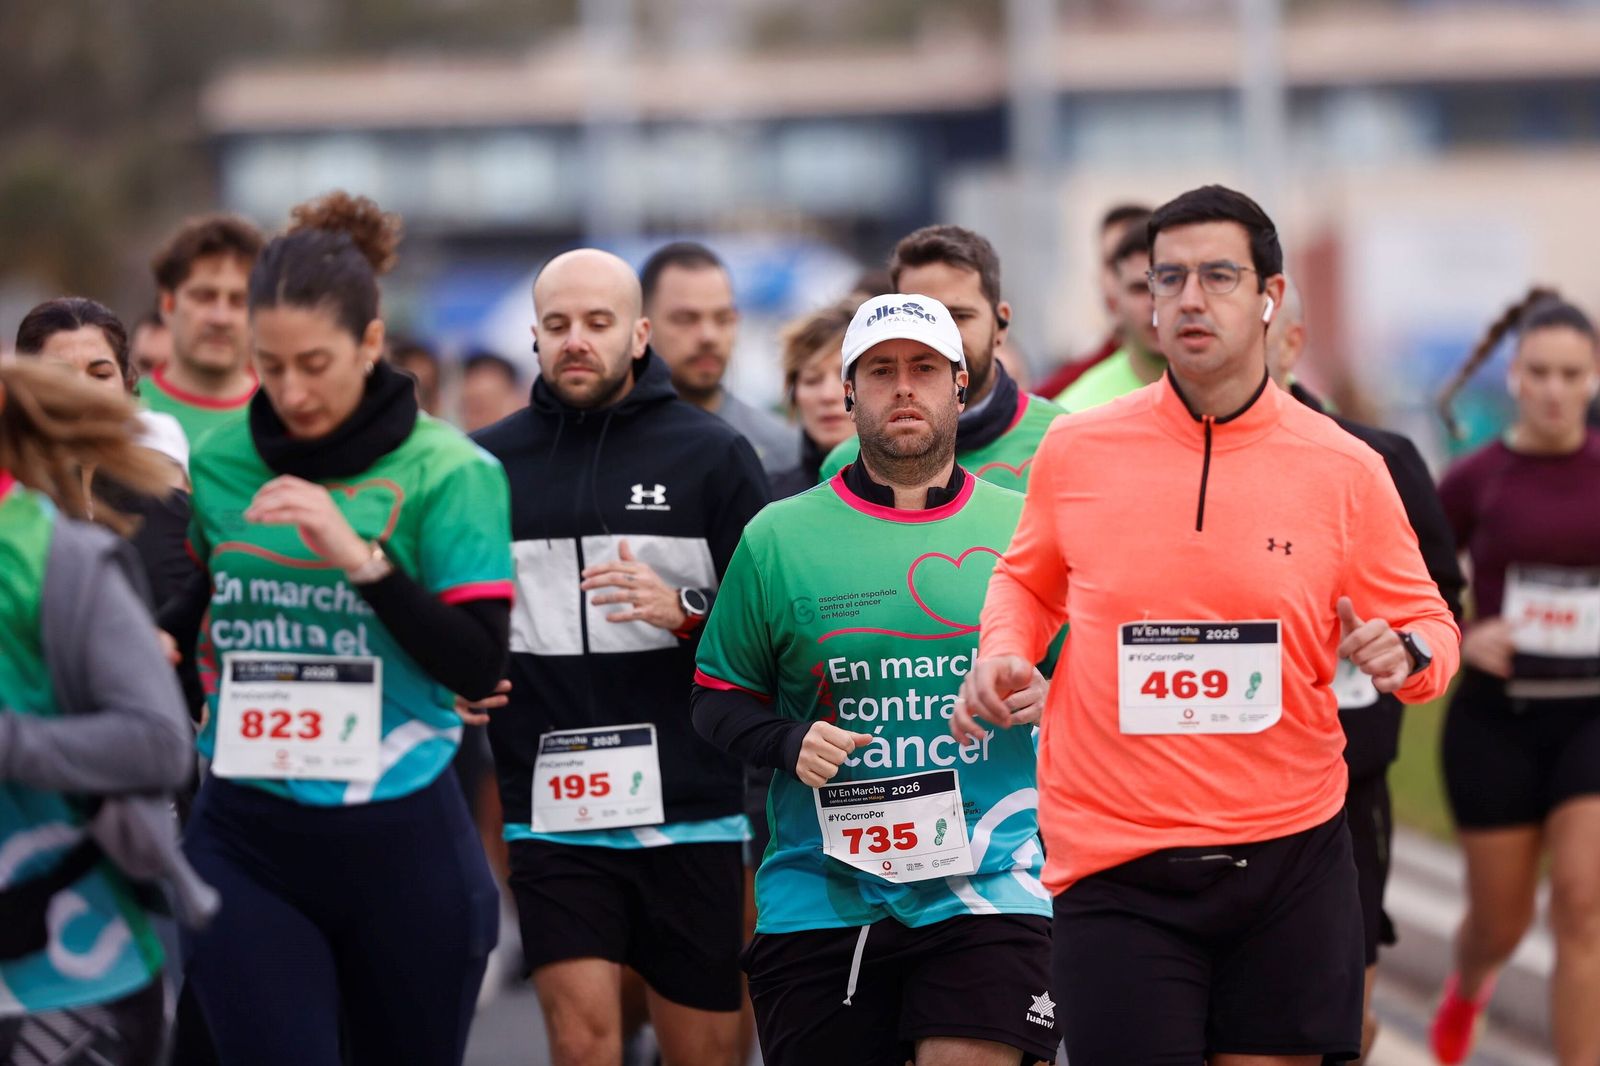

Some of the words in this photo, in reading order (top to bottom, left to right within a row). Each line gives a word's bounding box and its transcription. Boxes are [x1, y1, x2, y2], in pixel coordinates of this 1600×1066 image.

[866, 302, 936, 327] ellesse
[211, 571, 243, 604] En
[818, 592, 859, 603] asociación
[860, 588, 897, 599] española
[819, 602, 844, 612] contra
[846, 601, 853, 609] el
[854, 598, 881, 607] cáncer
[832, 609, 860, 619] Málaga
[333, 623, 371, 656] el
[1145, 626, 1159, 636] En
[1160, 625, 1200, 636] Marcha
[1206, 628, 1239, 640] 2026
[828, 656, 871, 684] En
[1140, 669, 1228, 699] 469
[241, 709, 322, 740] 823
[548, 772, 611, 800] 195
[828, 789, 837, 798] IV
[839, 788, 850, 797] En
[852, 785, 886, 796] Marcha
[891, 781, 921, 796] 2026
[828, 810, 885, 822] #YoCorroPor
[842, 821, 918, 855] 735
